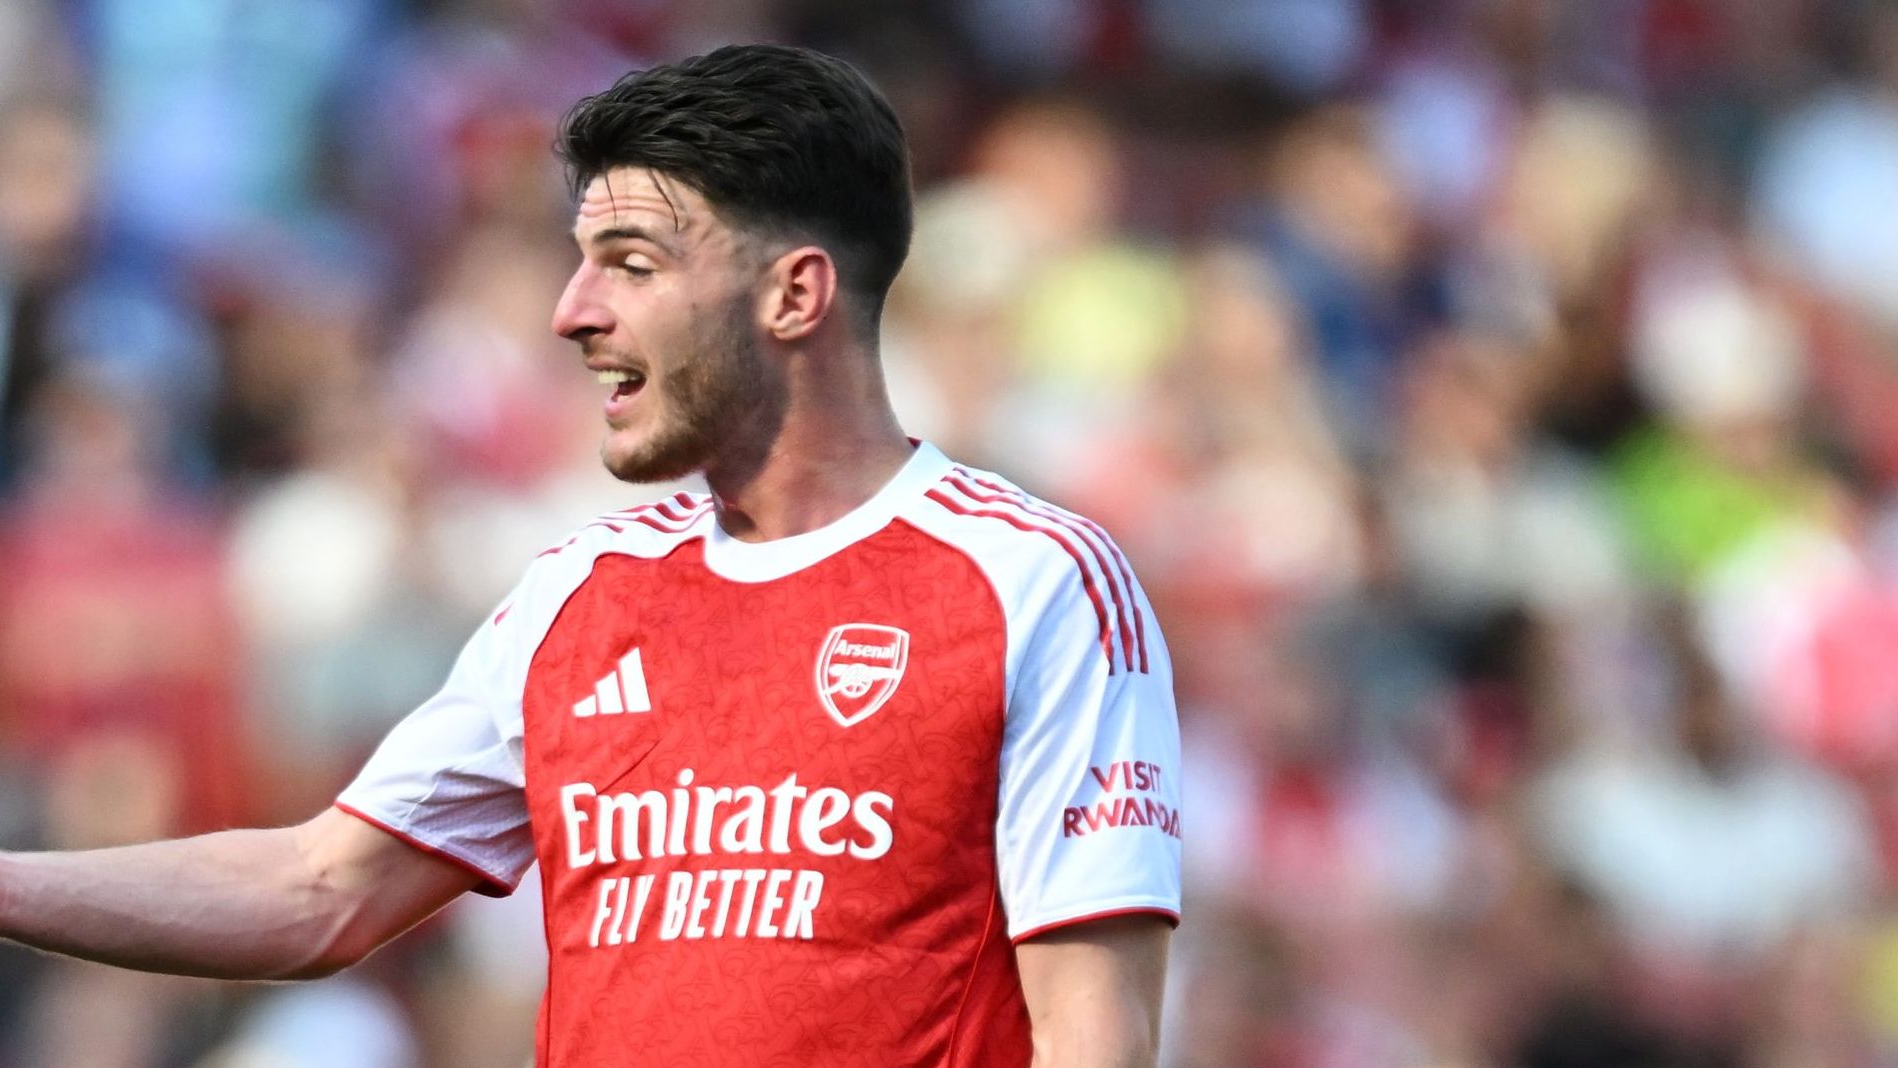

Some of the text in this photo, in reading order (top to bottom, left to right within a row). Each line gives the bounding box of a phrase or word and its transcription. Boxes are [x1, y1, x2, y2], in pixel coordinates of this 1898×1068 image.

[834, 639, 896, 660] Arsenal
[1090, 761, 1161, 793] VISIT
[560, 768, 894, 869] Emirates
[1063, 796, 1183, 840] RWANDA
[589, 869, 825, 948] FLY BETTER
